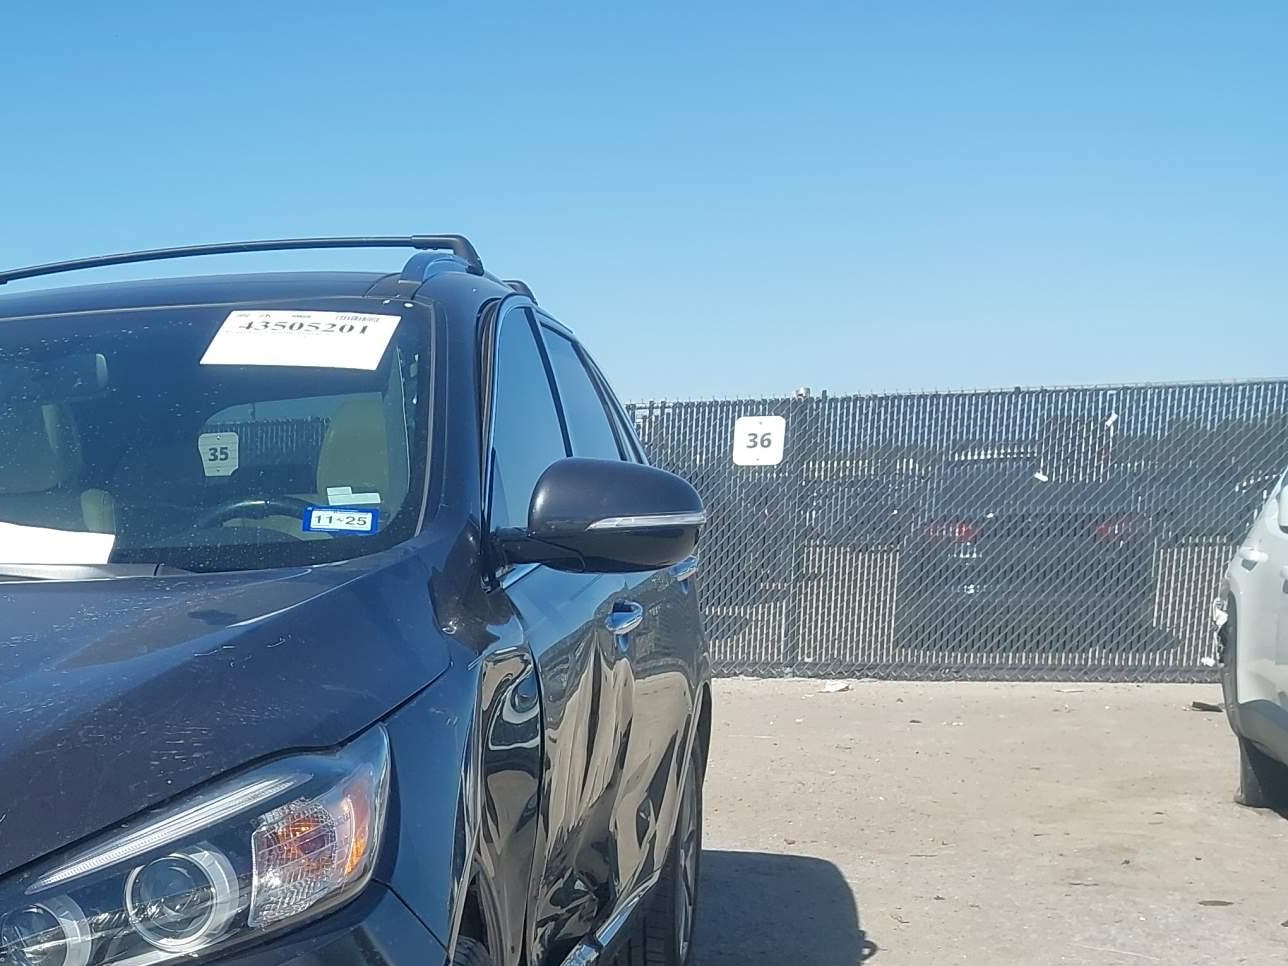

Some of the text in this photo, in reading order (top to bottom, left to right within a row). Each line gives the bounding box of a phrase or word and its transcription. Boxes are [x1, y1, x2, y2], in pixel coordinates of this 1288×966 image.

[238, 320, 369, 334] 43505201
[746, 432, 772, 448] 36
[208, 447, 229, 462] 35
